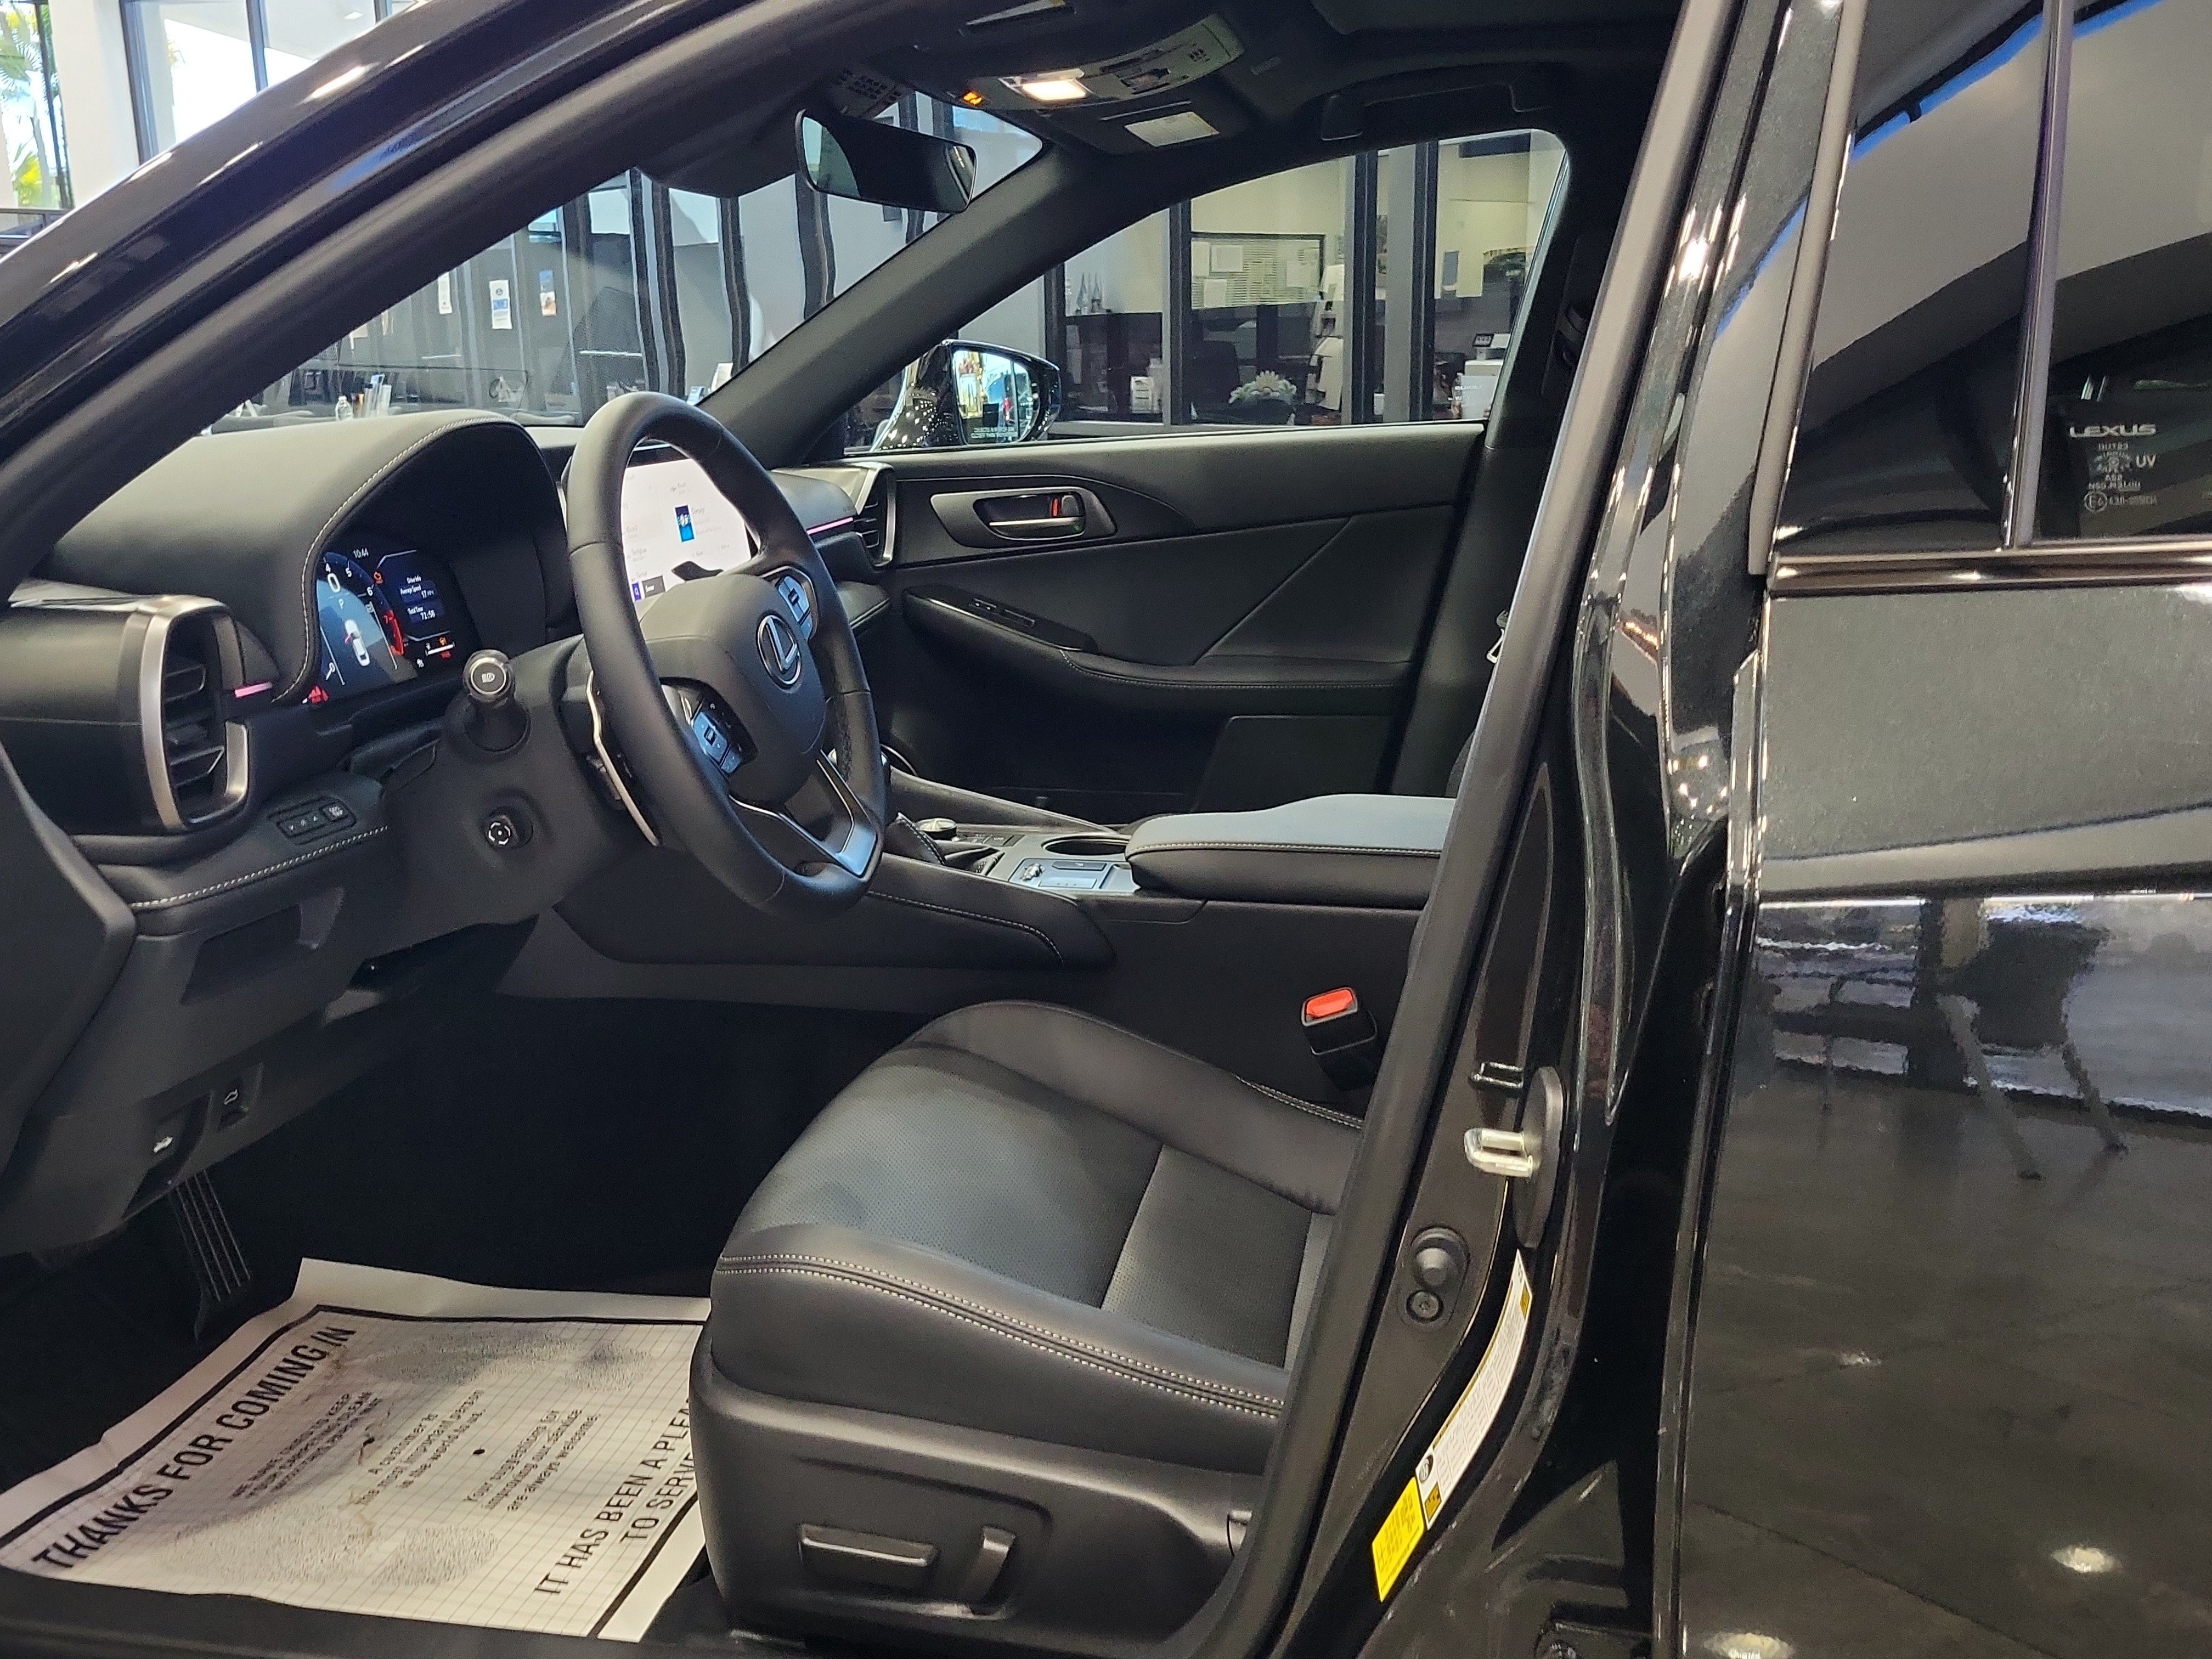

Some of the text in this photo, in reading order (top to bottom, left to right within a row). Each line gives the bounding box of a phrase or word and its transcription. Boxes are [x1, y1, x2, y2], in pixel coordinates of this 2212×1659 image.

[2069, 424, 2157, 438] LEXUS
[2136, 453, 2156, 468] UV
[325, 563, 331, 573] 4
[345, 568, 352, 578] 5
[327, 572, 341, 594] 0
[366, 586, 374, 596] 6
[31, 1483, 173, 1568] THANKS
[156, 1434, 233, 1480] FOR
[216, 1345, 329, 1430] COMING
[310, 1327, 357, 1347] IN
[534, 1572, 569, 1596] IT
[555, 1528, 610, 1568] HAS
[595, 1475, 654, 1522] BEEN
[640, 1457, 668, 1470] A
[619, 1517, 659, 1543] TO
